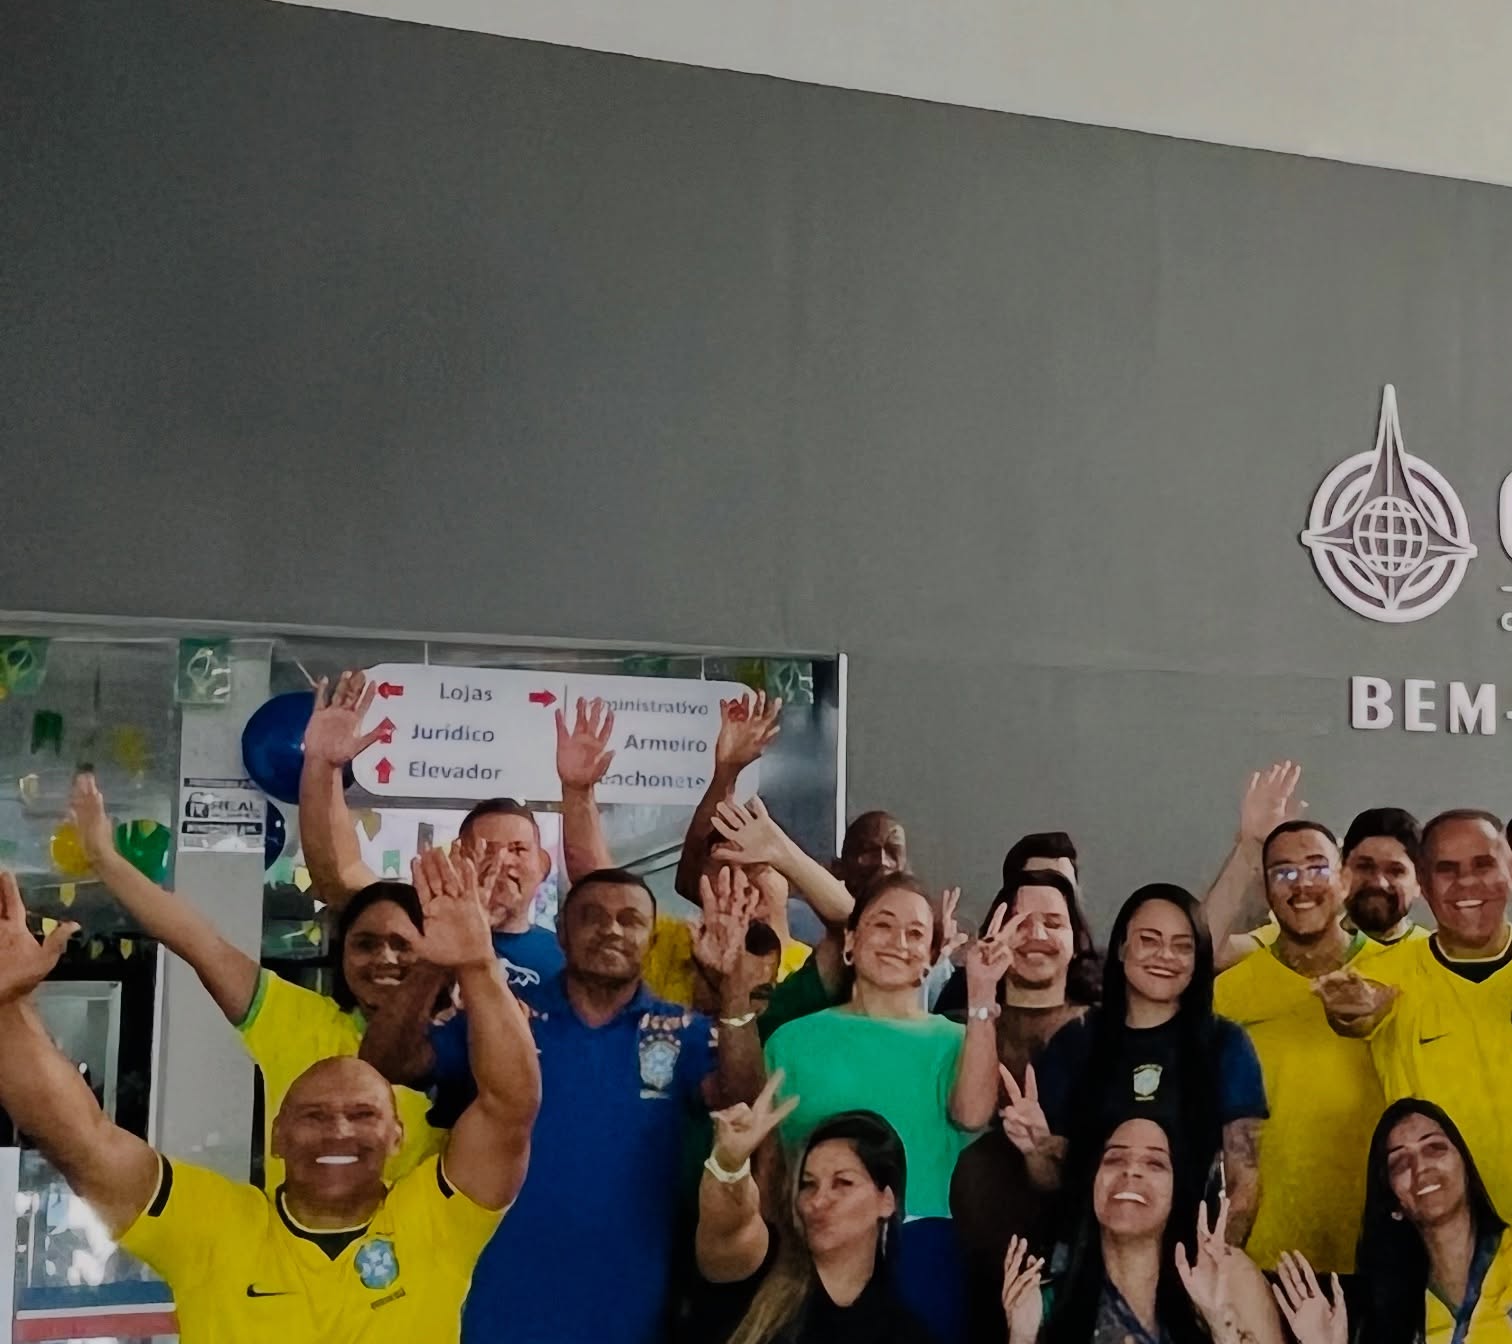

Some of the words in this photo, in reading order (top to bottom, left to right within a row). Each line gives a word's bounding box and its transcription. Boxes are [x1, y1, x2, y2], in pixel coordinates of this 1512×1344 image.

[439, 682, 493, 703] Lojas
[606, 698, 708, 716] ministrativo
[411, 723, 495, 743] Jurídico
[624, 733, 708, 753] Armeiro
[408, 760, 503, 781] Elevador
